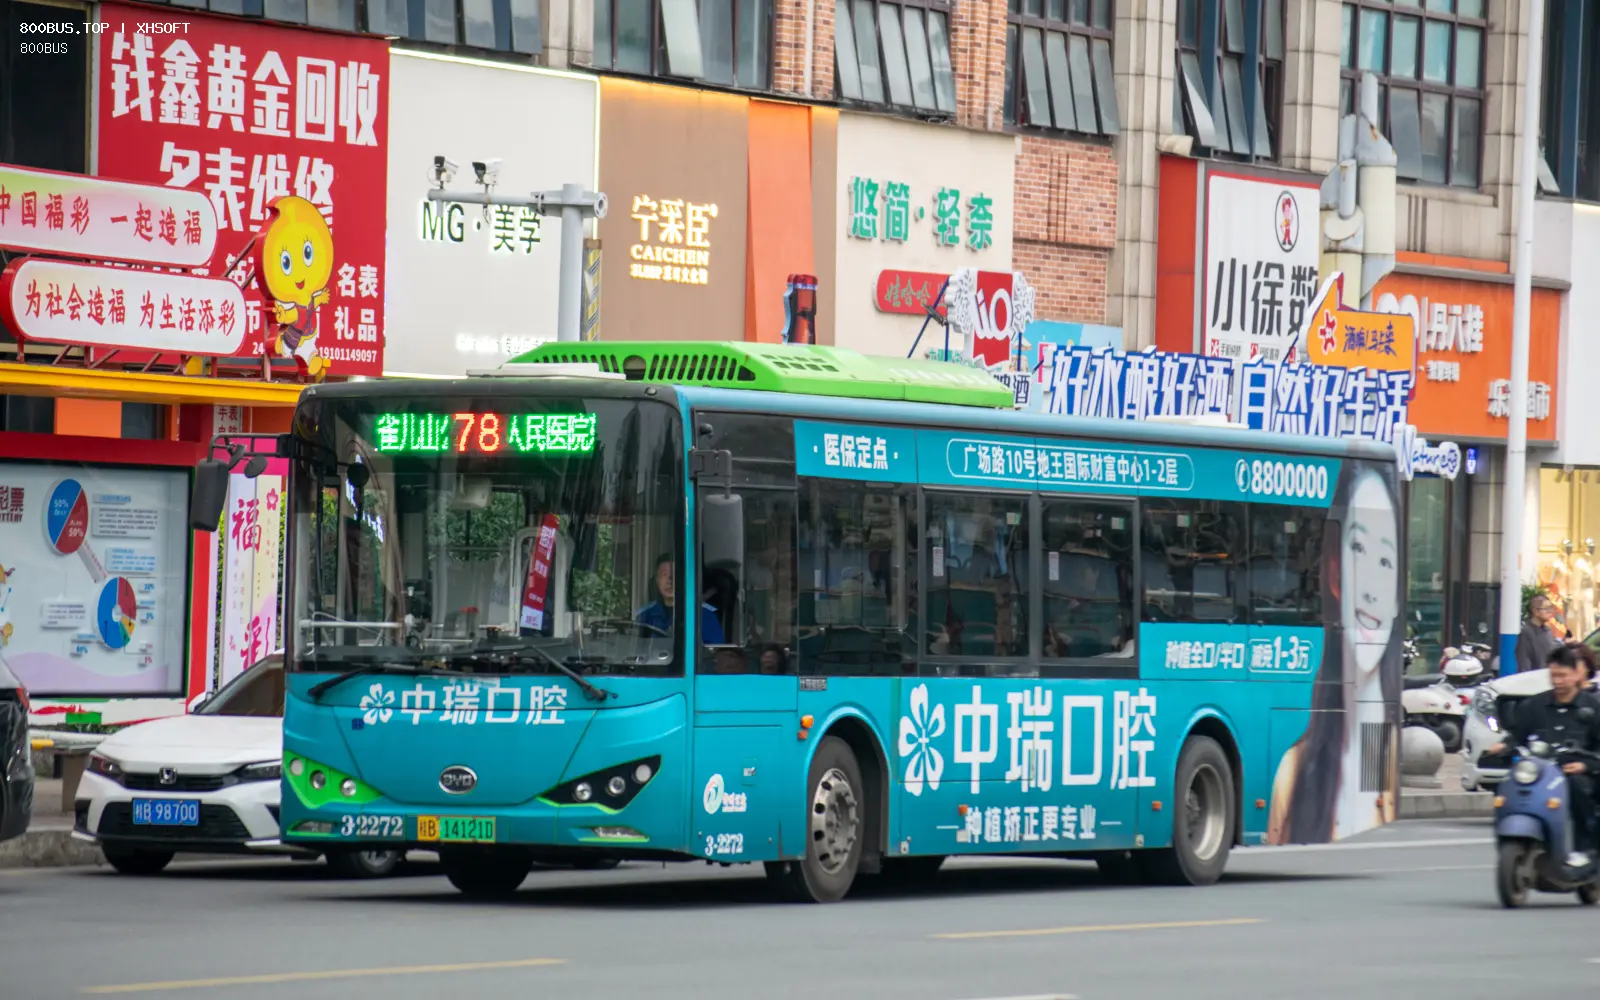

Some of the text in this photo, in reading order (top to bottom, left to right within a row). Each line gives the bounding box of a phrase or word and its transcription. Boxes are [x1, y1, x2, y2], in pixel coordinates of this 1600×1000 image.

[110, 202, 202, 247] 一起造福
[630, 244, 710, 266] CAICHEN
[338, 264, 379, 298] 名表
[25, 279, 237, 338] 为社会造福 为生活添彩
[334, 307, 378, 342] 礼品
[1049, 346, 1409, 443] 好水酿好酒 自然好生活
[453, 413, 500, 452] 78
[507, 412, 596, 452] 人民医院
[823, 433, 889, 470] 医保定点
[1251, 459, 1328, 500] 8800000
[232, 498, 262, 553] 福
[400, 683, 567, 726] 中瑞口腔
[953, 684, 1157, 795] 中瑞口腔
[155, 803, 197, 822] 98700
[443, 819, 494, 839] 14121D
